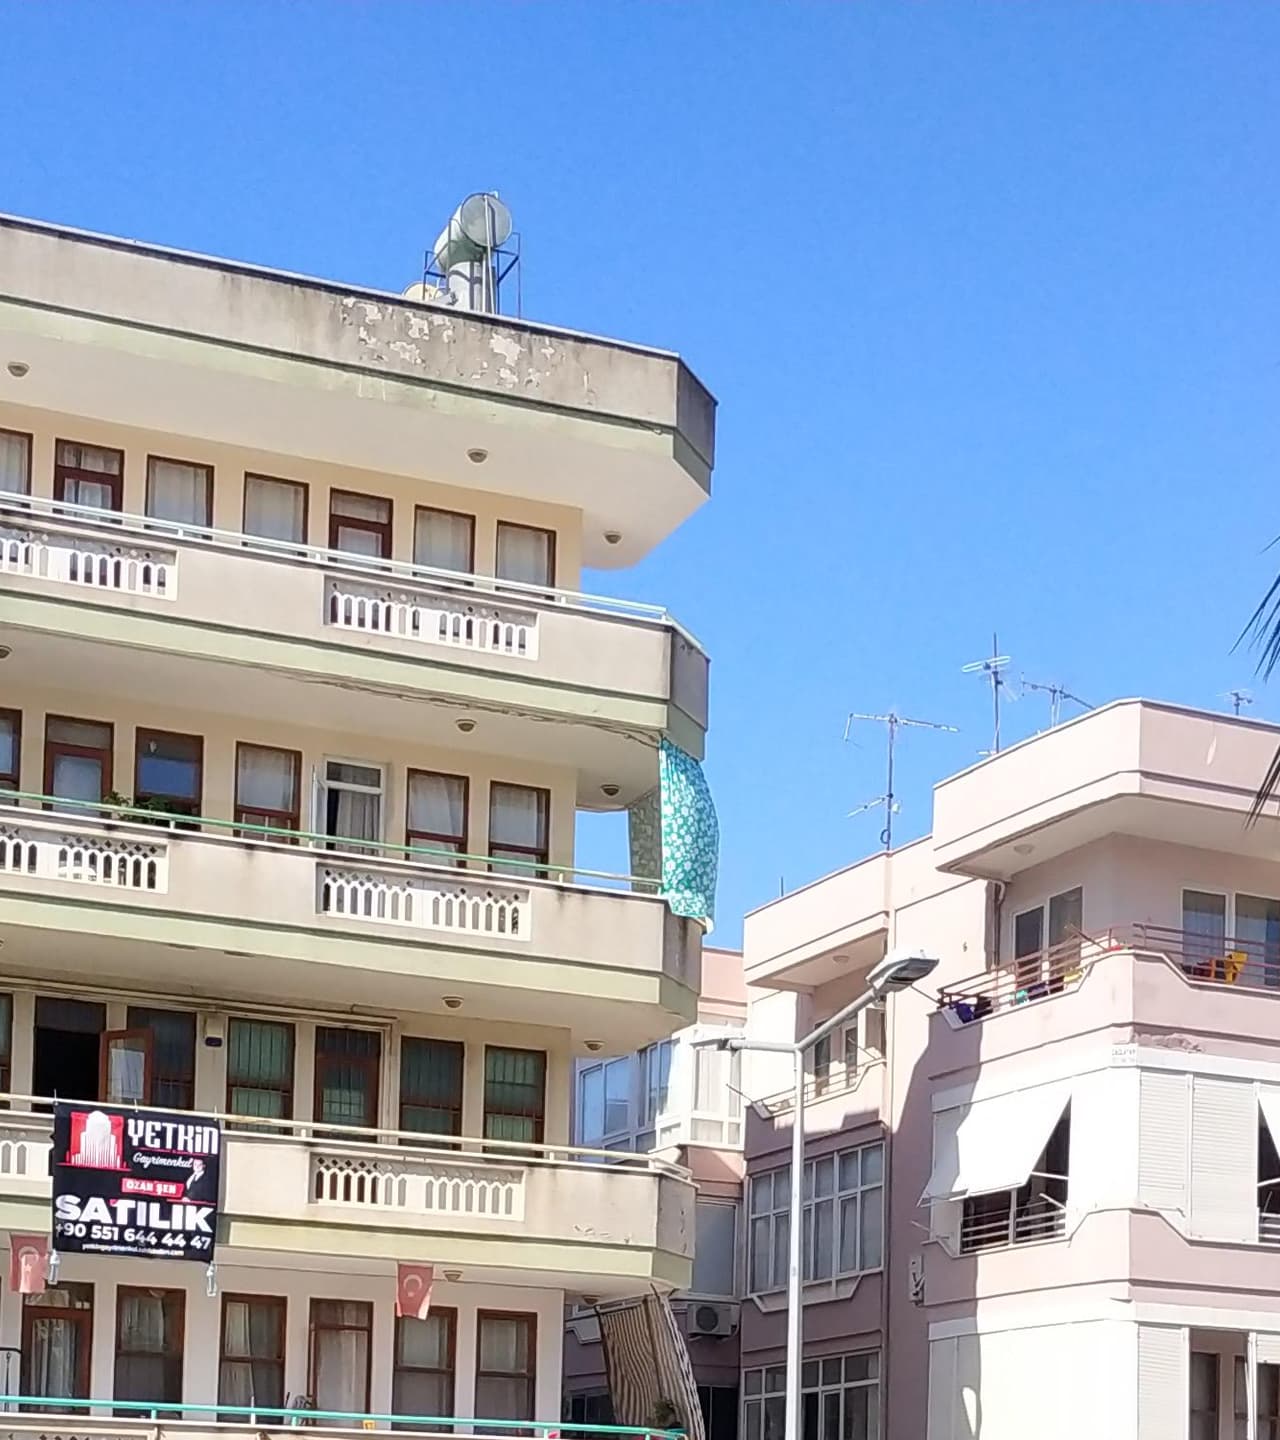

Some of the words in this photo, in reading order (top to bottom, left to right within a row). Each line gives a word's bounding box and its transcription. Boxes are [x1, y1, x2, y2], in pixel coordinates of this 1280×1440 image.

[55, 1194, 214, 1233] SATILIK
[55, 1222, 86, 1238] +90
[91, 1225, 119, 1240] 551
[123, 1228, 157, 1246] 644
[161, 1232, 187, 1248] 44
[190, 1235, 212, 1250] 47
